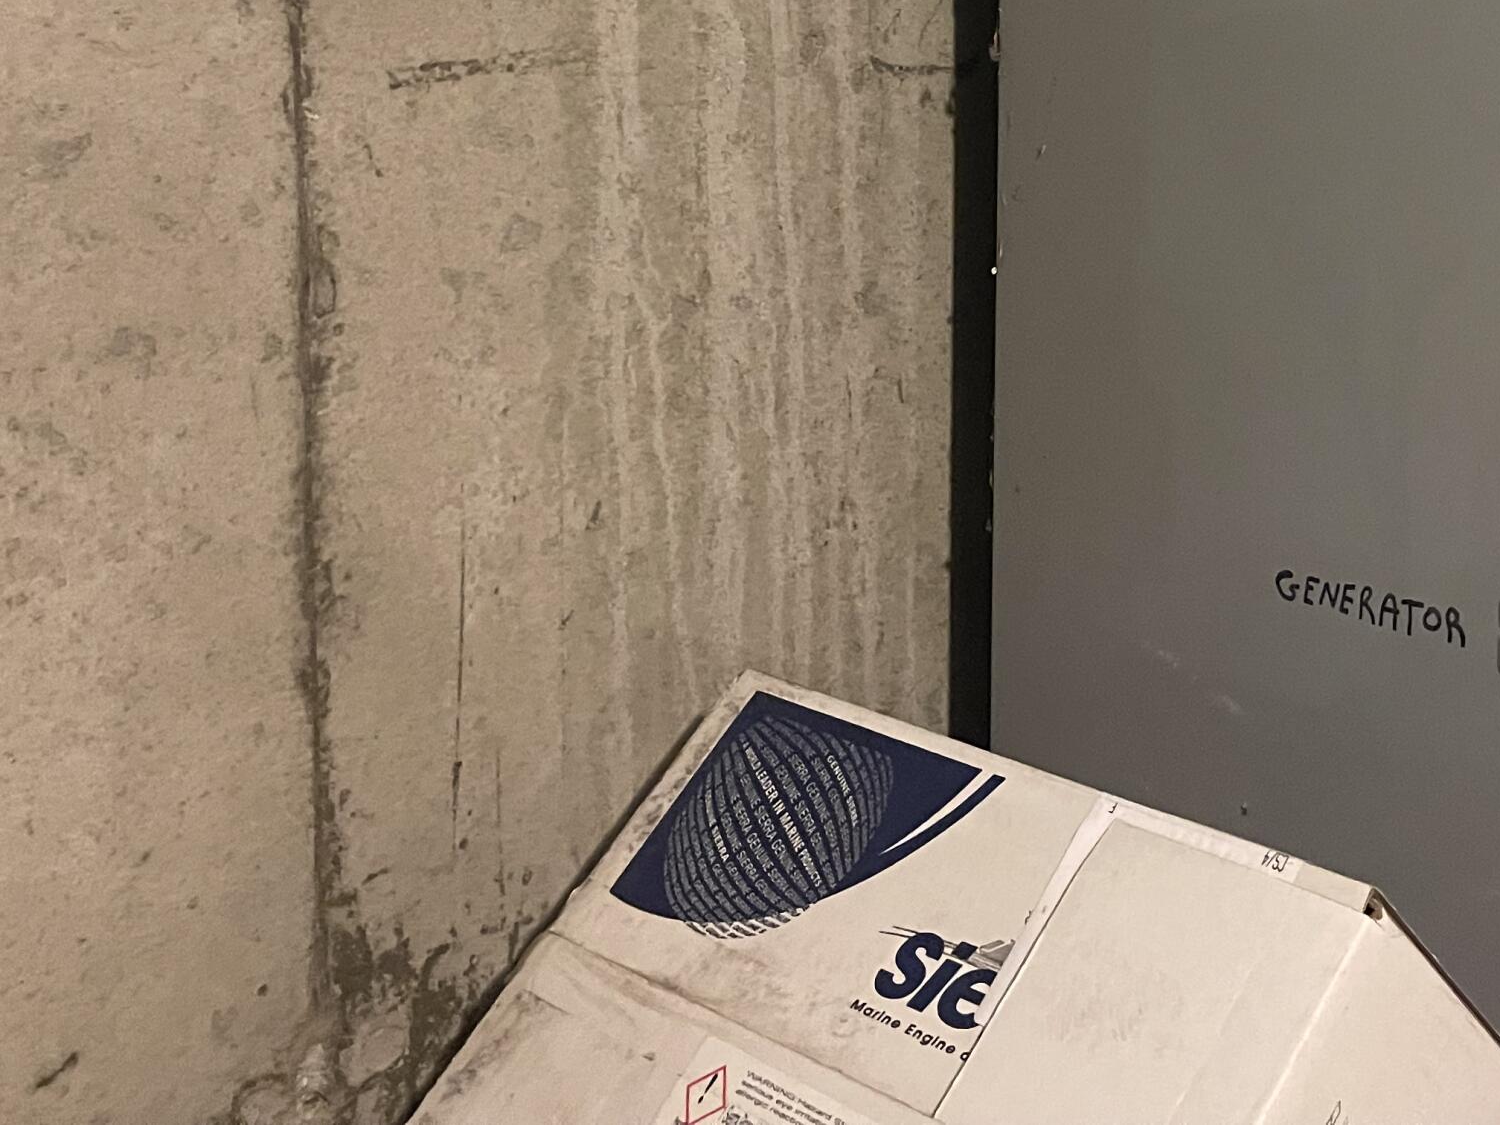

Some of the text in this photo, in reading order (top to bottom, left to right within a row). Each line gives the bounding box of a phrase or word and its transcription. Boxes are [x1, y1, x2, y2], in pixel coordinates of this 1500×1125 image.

[1275, 569, 1466, 648] GENERATOR
[753, 767, 780, 803] LEADER
[825, 753, 851, 796] GENUINE
[751, 804, 779, 842] SIERRA
[770, 798, 786, 815] IN
[791, 798, 818, 836] SIERRA
[708, 824, 731, 863] SIERRA
[777, 811, 806, 853] MARINE
[796, 848, 824, 888] PRODUCTS
[850, 999, 900, 1029] Marine
[904, 1024, 956, 1054] Engine
